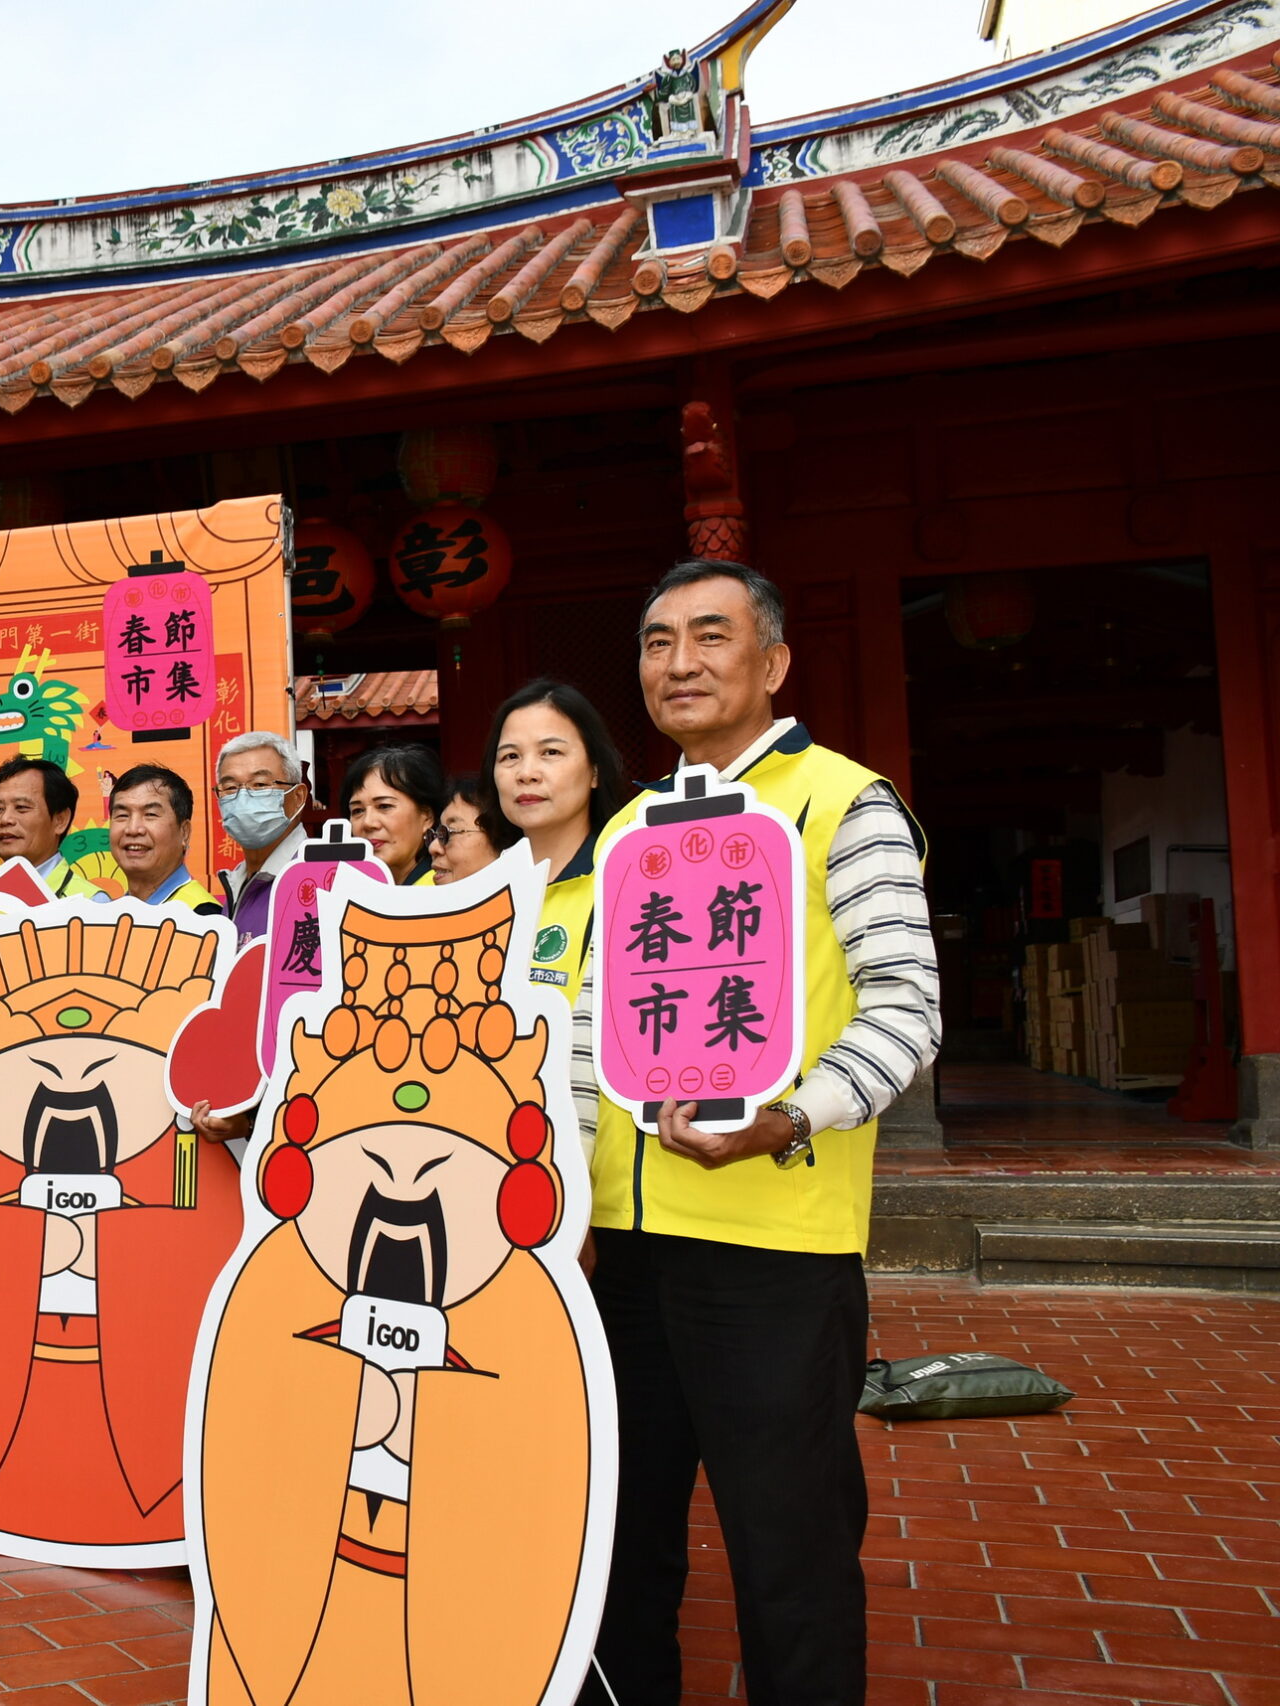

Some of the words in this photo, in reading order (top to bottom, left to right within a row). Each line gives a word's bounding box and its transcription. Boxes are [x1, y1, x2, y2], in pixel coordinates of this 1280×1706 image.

[395, 518, 489, 599] 彰
[117, 609, 196, 654] 春節
[121, 661, 202, 706] 市集
[643, 831, 751, 877] 彰化市
[625, 880, 763, 963] 春節
[628, 975, 768, 1056] 市集
[648, 1067, 733, 1091] 一一三
